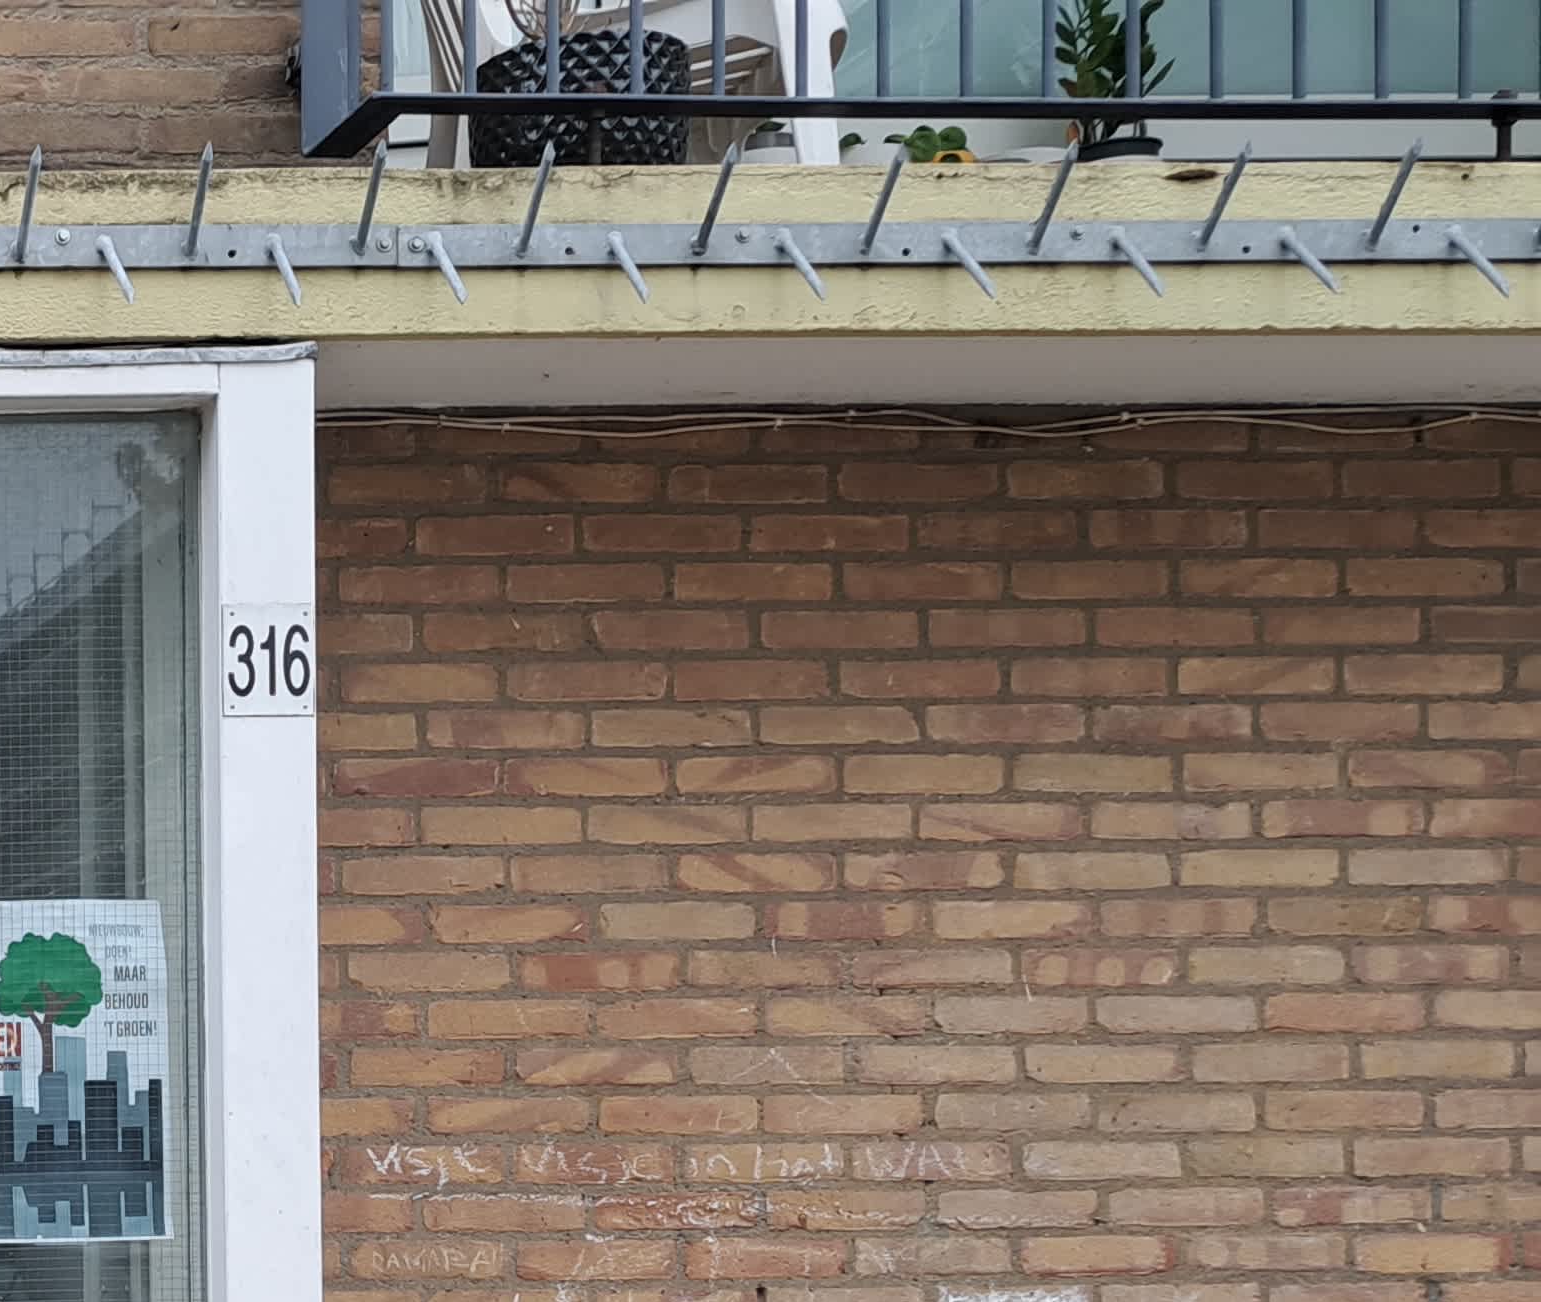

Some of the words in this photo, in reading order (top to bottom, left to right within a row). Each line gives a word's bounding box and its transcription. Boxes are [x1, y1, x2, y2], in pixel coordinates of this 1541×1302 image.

[228, 624, 310, 697] 316
[114, 965, 146, 981] MAAR
[104, 992, 149, 1010] BEHOUD
[116, 1020, 158, 1038] GROEN!
